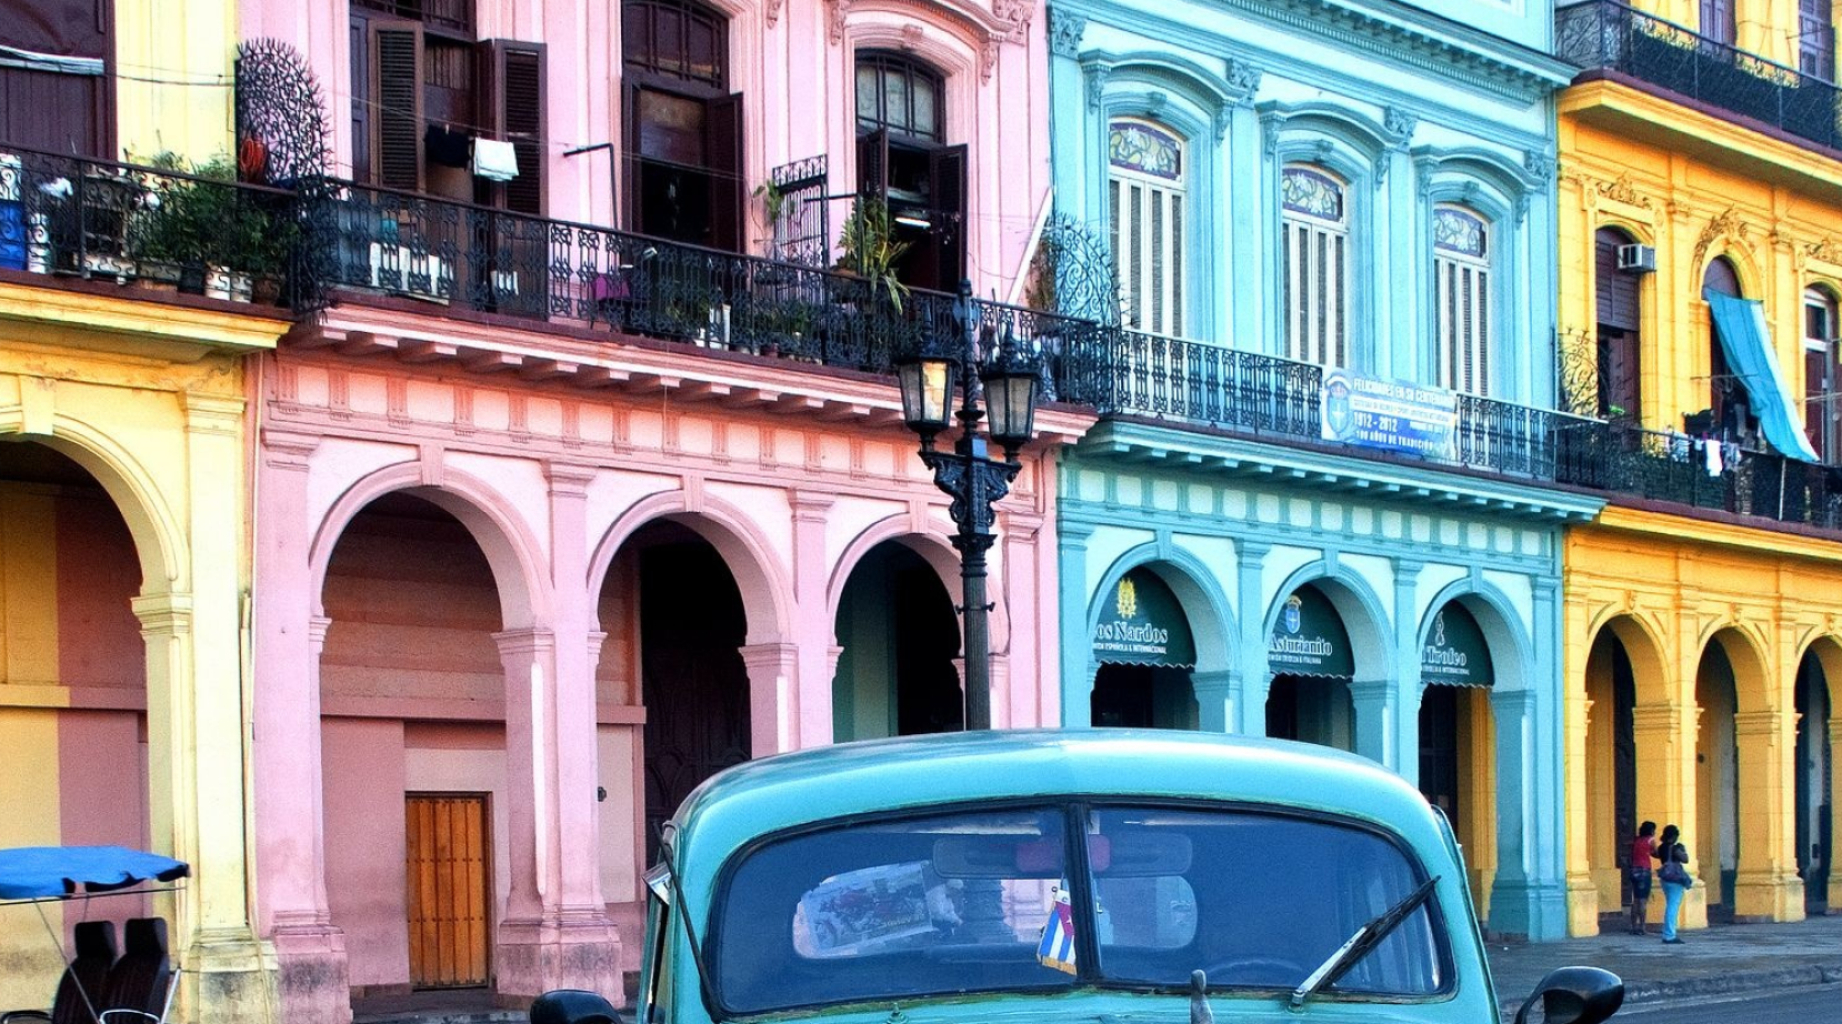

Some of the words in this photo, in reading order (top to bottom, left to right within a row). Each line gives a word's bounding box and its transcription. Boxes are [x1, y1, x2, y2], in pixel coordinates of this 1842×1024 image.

[1395, 385, 1404, 398] EN
[1353, 411, 1372, 428] 1912
[1378, 415, 1398, 433] 2012
[1388, 434, 1397, 445] DE
[1096, 623, 1113, 640] os
[1113, 621, 1168, 643] Nardos
[1426, 645, 1467, 666] Trofeo
